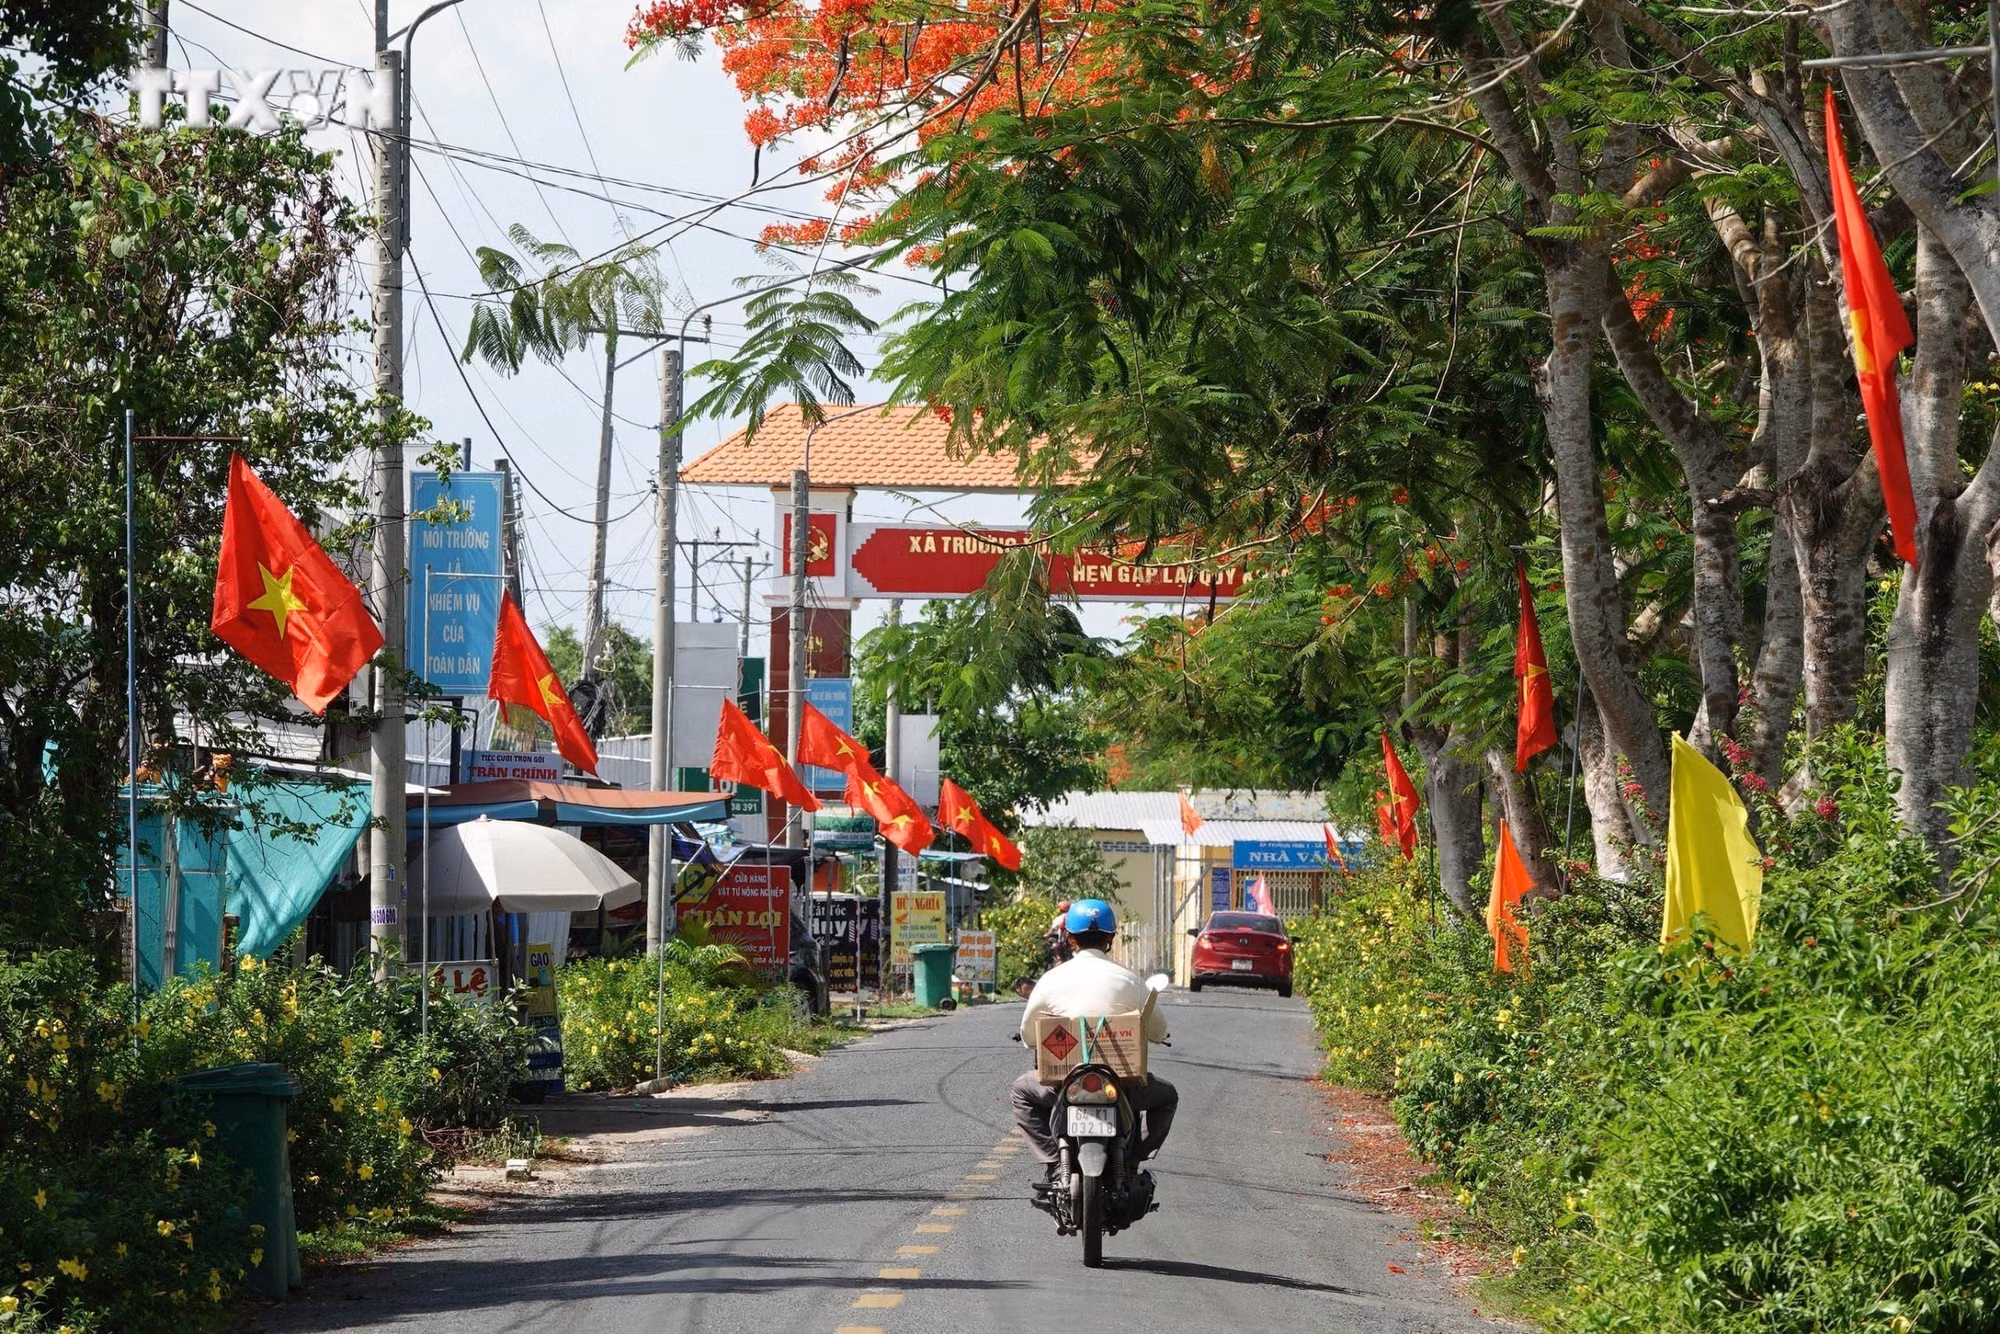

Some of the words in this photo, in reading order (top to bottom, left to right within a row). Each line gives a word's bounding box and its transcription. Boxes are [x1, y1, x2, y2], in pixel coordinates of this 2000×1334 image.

[423, 525, 443, 549] MÔI
[446, 526, 489, 549] TRƯỜNG
[909, 532, 936, 553] XÃ
[448, 557, 462, 580] LÀ
[1073, 564, 1112, 588] HẸN
[466, 593, 480, 616] VỤ
[443, 618, 464, 643] CỦA
[428, 652, 454, 674] TOÀN
[458, 652, 480, 675] DÂN
[742, 803, 758, 812] 391
[1249, 850, 1290, 862] NHÀ
[749, 873, 767, 884] HÀNG
[1072, 1121, 1113, 1134] 032.18
